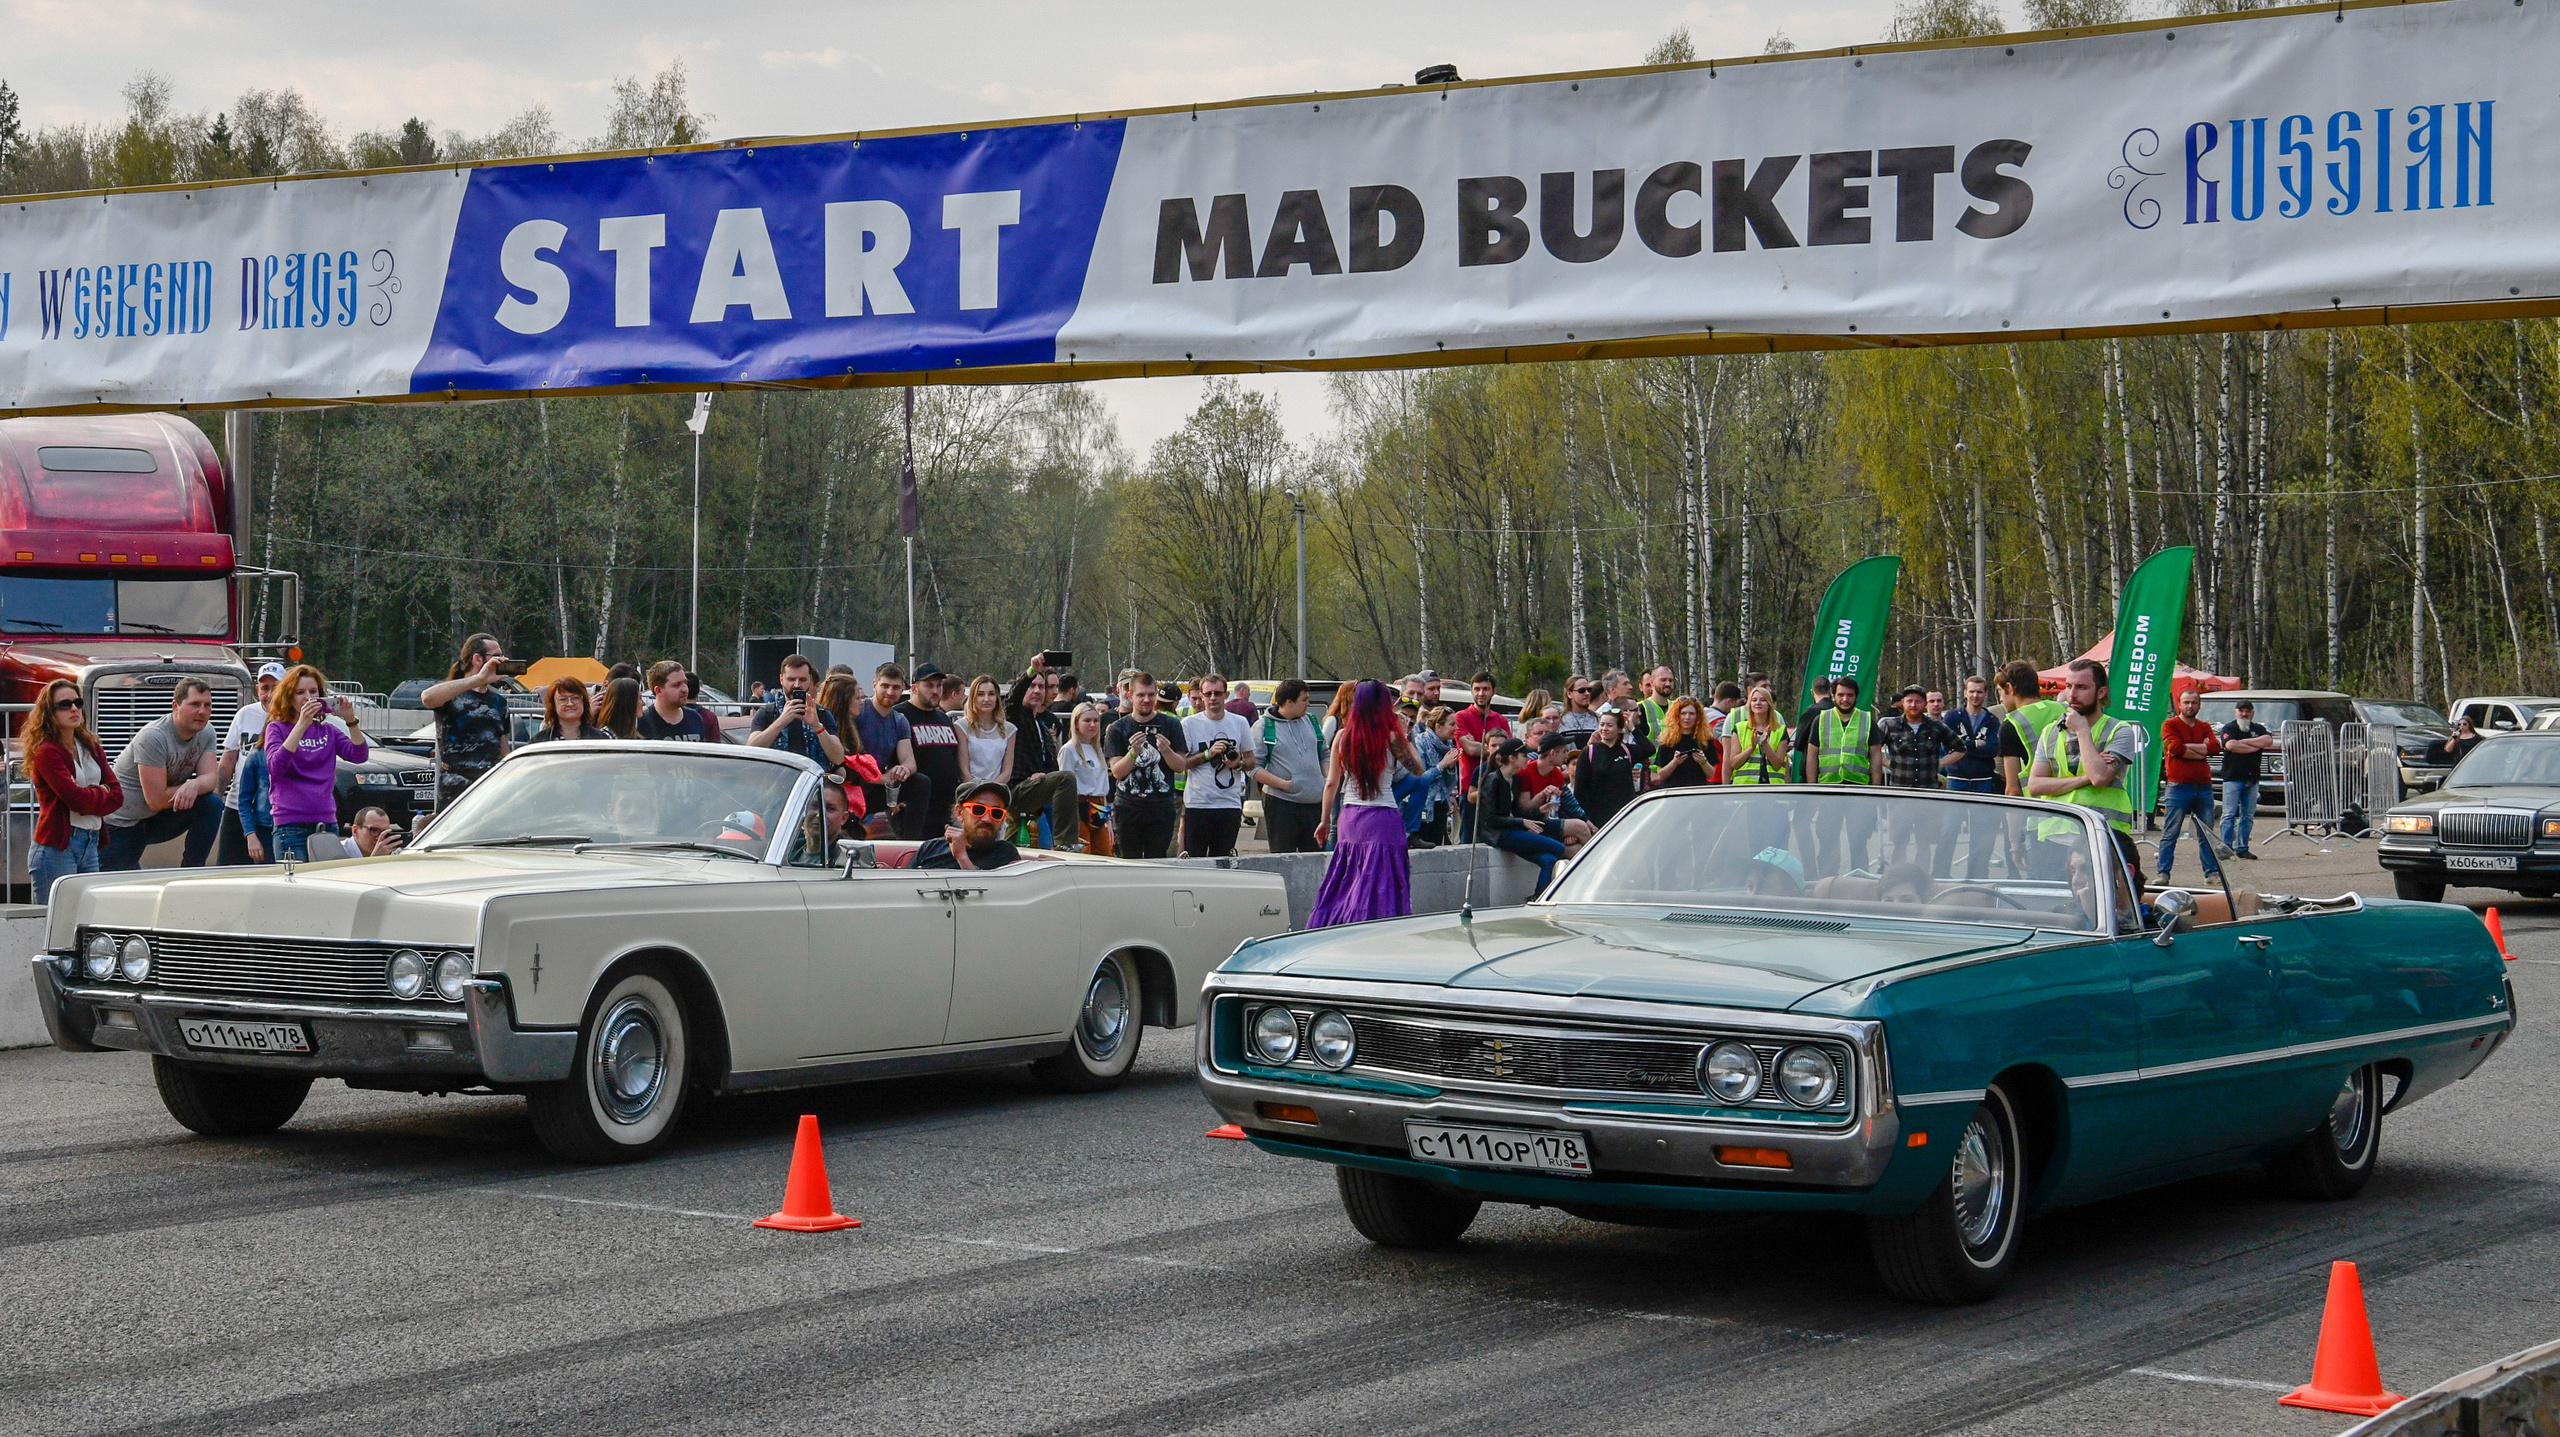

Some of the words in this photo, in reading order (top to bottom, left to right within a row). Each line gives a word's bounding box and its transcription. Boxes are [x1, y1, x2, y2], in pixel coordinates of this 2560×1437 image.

[2184, 100, 2496, 225] RUSSIAN
[1153, 184, 1425, 284] MAD
[1458, 139, 2034, 266] BUCKETS
[494, 190, 1021, 335] START
[39, 260, 213, 340] WEEKEND
[241, 250, 359, 330] DRAGS
[1827, 619, 1852, 683] EEDOM
[2124, 614, 2150, 710] FREEDOM
[2137, 653, 2157, 712] finance
[912, 725, 958, 745] MARVE
[2496, 858, 2513, 866] 197
[268, 1028, 300, 1044] 178
[1535, 1137, 1579, 1160] 178
[1549, 1157, 1571, 1167] RUS
